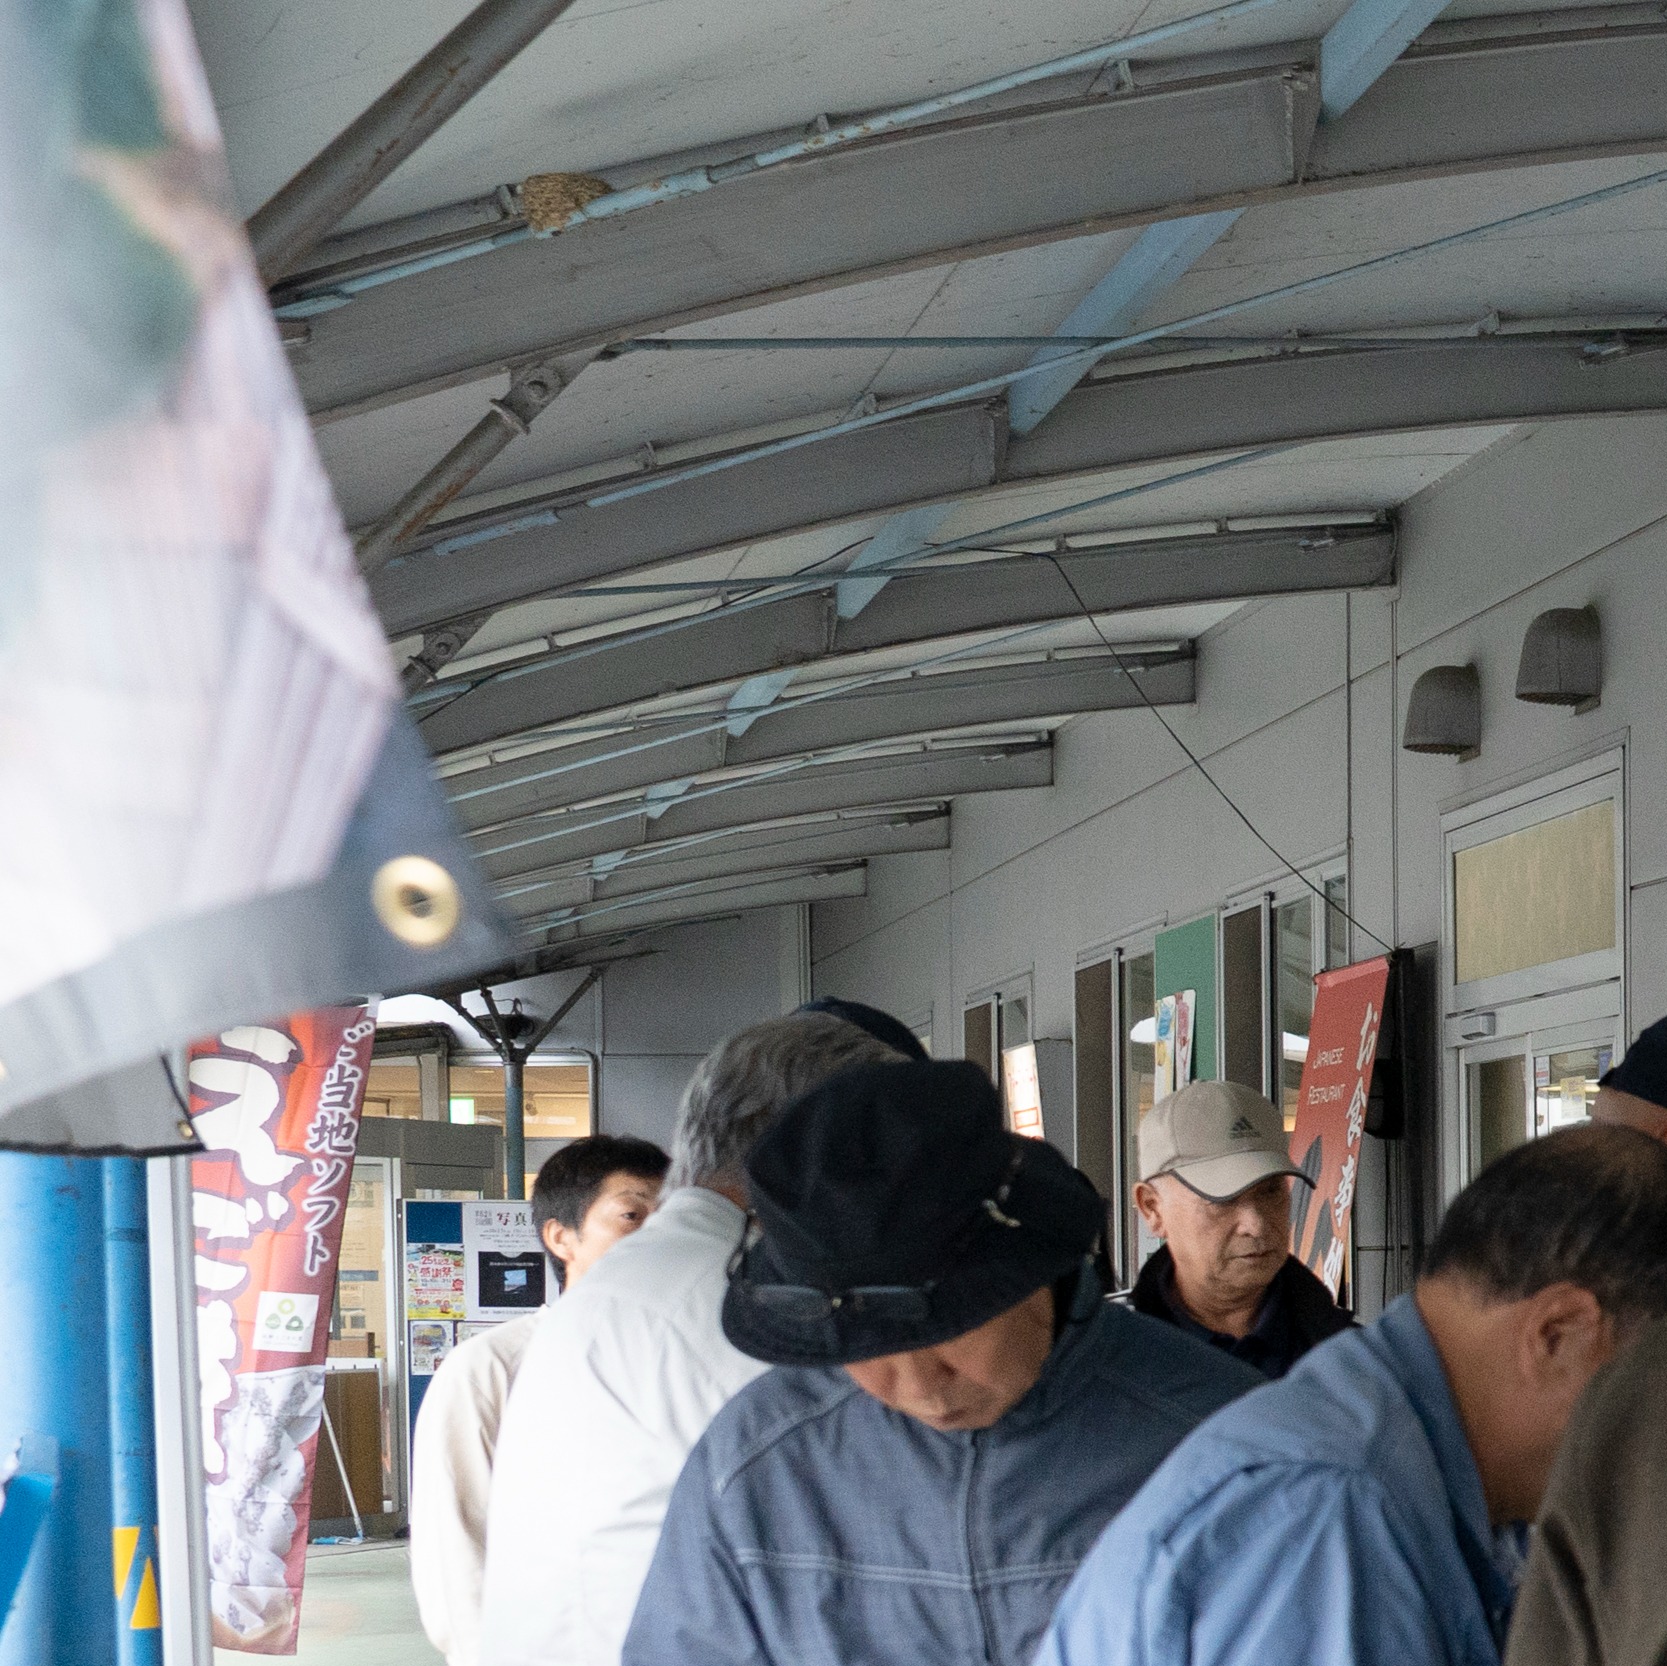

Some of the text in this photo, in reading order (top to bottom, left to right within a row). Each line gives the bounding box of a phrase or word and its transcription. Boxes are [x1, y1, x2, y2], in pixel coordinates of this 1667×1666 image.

[305, 1019, 374, 1278] ご当地ソフト
